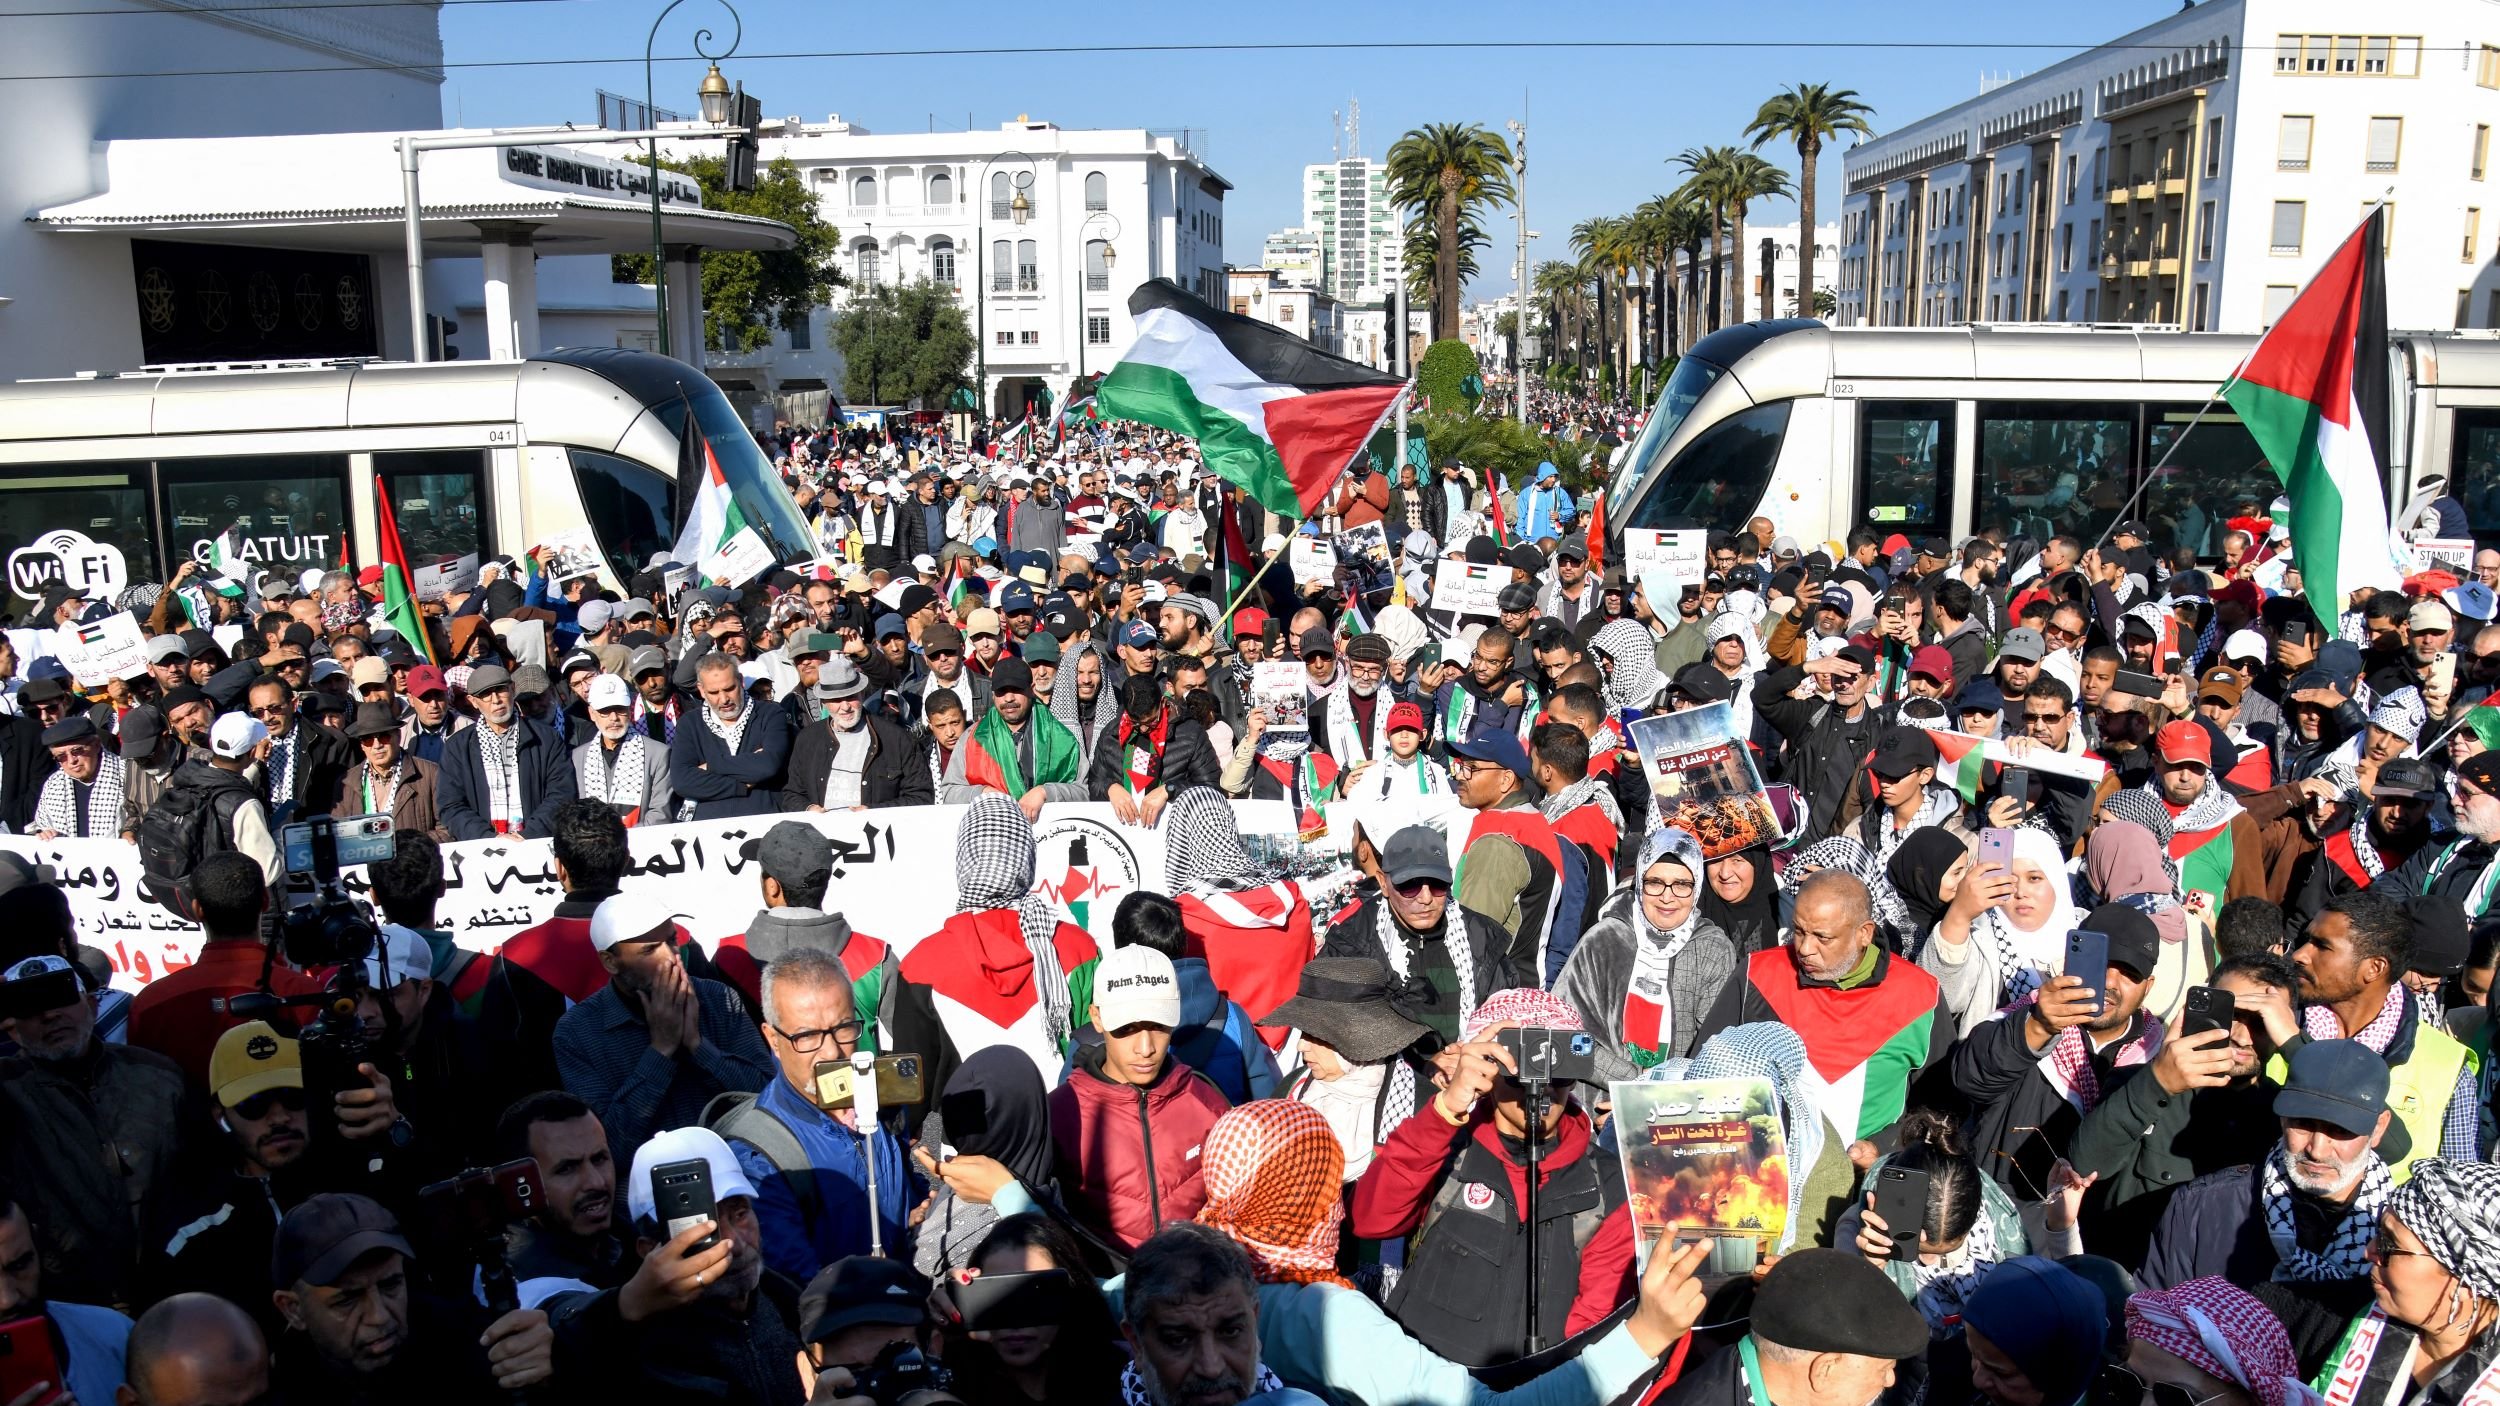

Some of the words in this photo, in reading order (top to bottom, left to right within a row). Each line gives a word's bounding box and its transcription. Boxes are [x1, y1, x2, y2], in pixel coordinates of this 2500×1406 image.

[507, 148, 543, 177] GARE
[1835, 384, 1854, 394] 023
[489, 431, 512, 442] 041
[193, 534, 330, 564] GATUIT
[1635, 548, 1656, 561] أمانة
[1659, 551, 1698, 564] فلسطين
[2420, 550, 2450, 561] STAND
[2452, 551, 2465, 562] UP
[423, 575, 442, 588] أمانة
[1444, 579, 1466, 591] أمانة
[1440, 593, 1463, 605] خيانة
[96, 637, 136, 662] فلسطين
[79, 668, 100, 680] خيانة
[1679, 754, 1709, 769] اطفال
[1711, 749, 1728, 761] عن
[1660, 761, 1678, 772] غزة
[1049, 825, 1078, 838] فلسطين
[1080, 827, 1101, 837] لدعم
[93, 910, 142, 934] شعار
[464, 905, 532, 931] تنظم
[1135, 974, 1170, 987] Angels
[1687, 1125, 1714, 1140] تحت
[898, 1364, 922, 1372] Nikon
